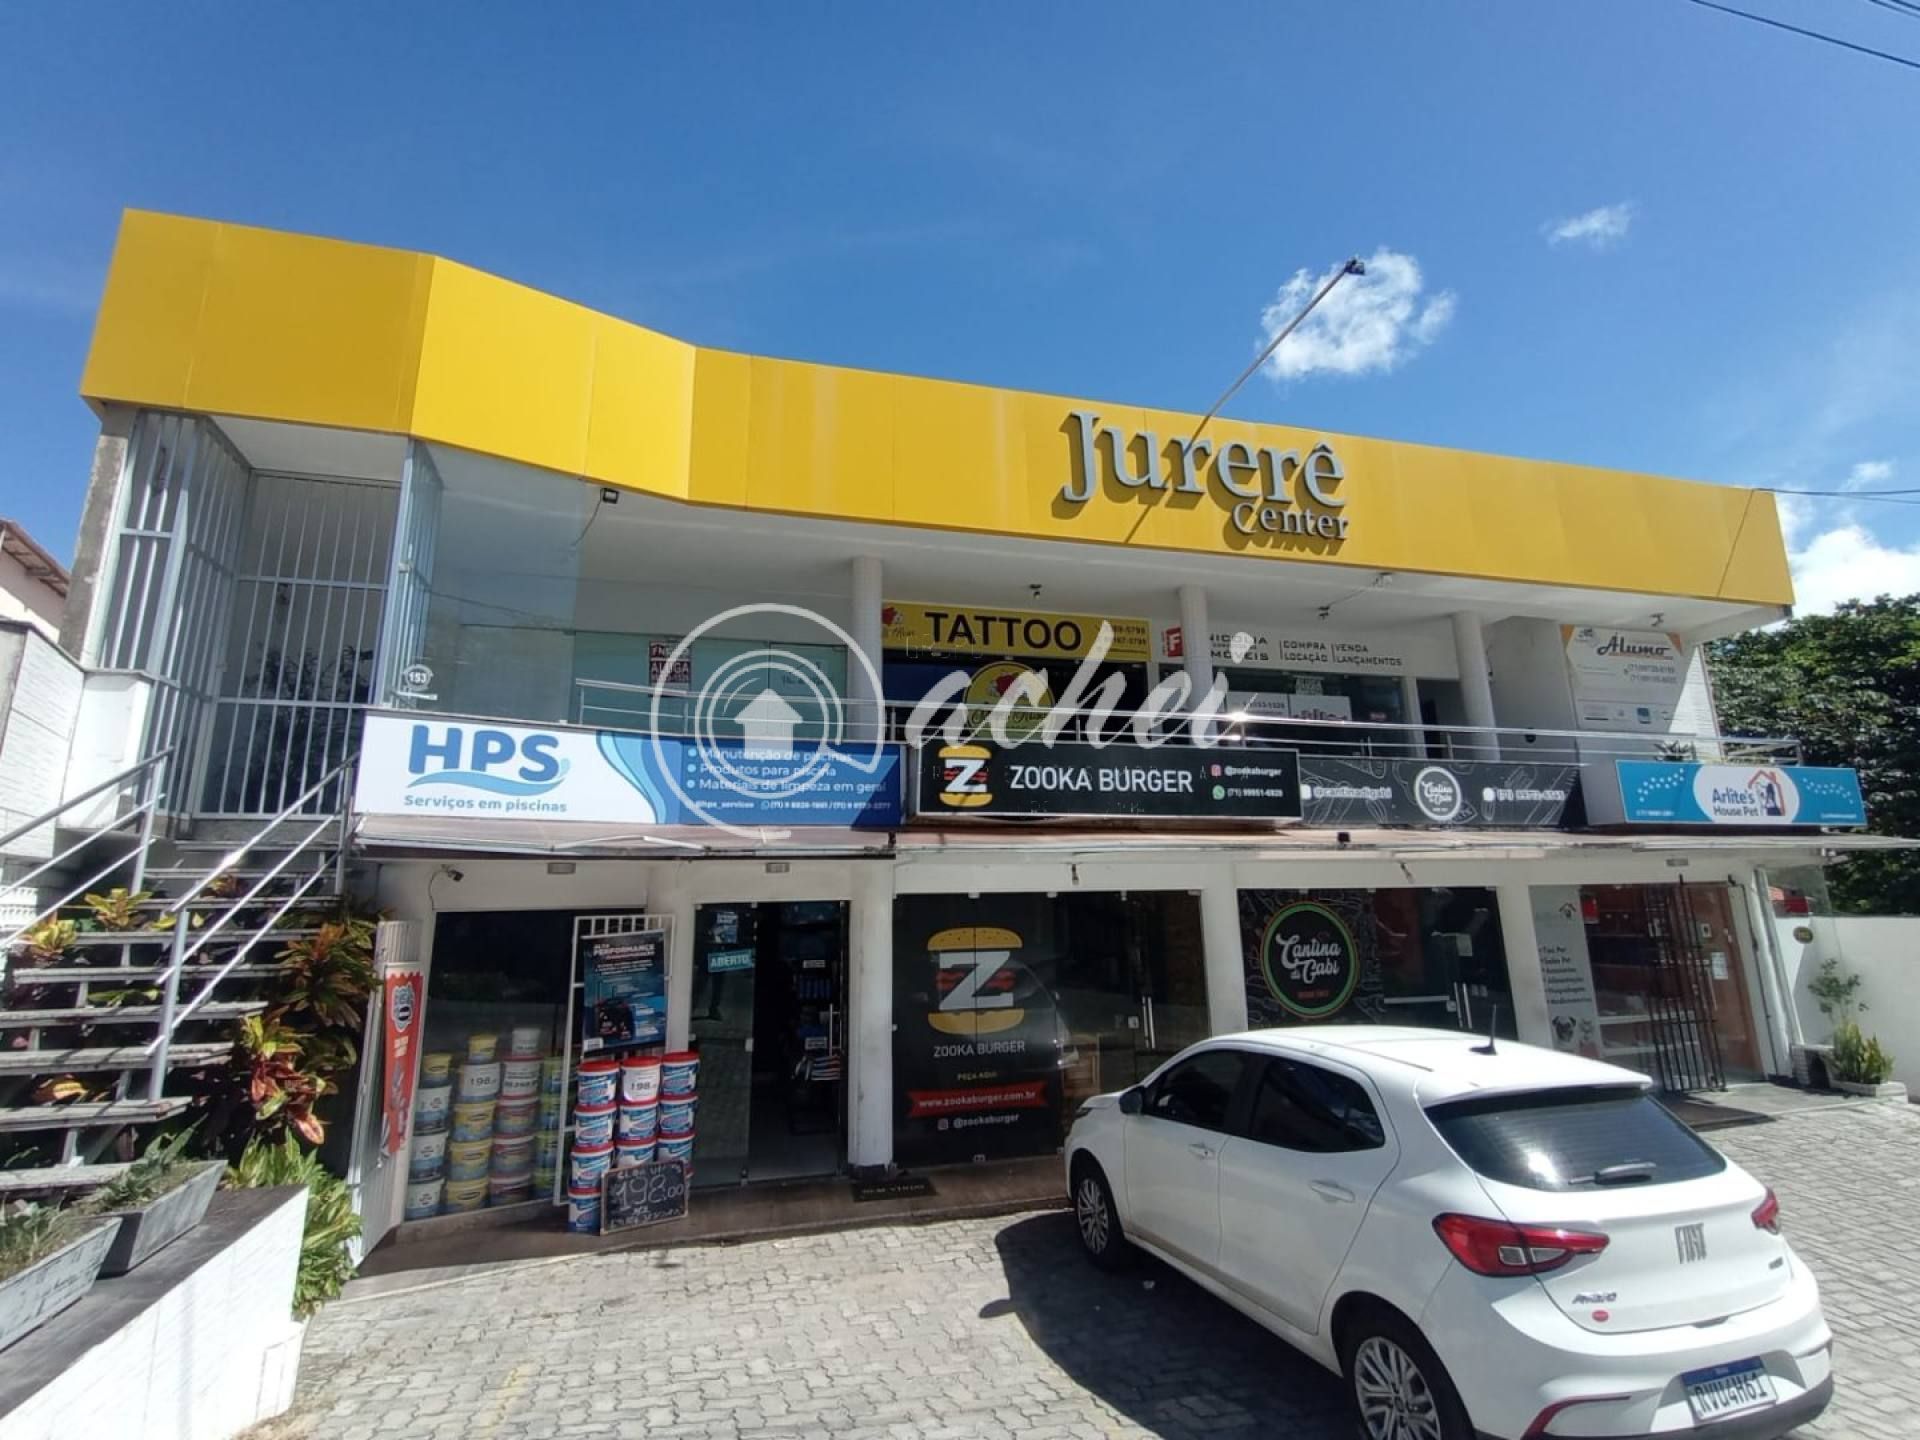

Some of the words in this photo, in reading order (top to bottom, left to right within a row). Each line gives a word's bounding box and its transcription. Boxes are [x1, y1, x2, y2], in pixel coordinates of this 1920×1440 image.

[1062, 409, 1348, 507] Jurerê
[1232, 502, 1349, 540] Center
[924, 611, 1082, 651] TATTOO
[1283, 640, 1327, 651] COMPRA
[1334, 643, 1369, 653] VENDA
[1284, 651, 1329, 663] LOCAÇÃO
[1336, 653, 1403, 667] LANÇAMENTOS
[407, 724, 561, 782] HPS
[700, 764, 759, 776] Produtos
[762, 765, 790, 778] para
[1009, 765, 1093, 792] ZOOKA
[1099, 767, 1194, 793] BURGER
[761, 780, 776, 791] de
[833, 782, 853, 792] em
[856, 781, 887, 794] geral
[404, 795, 475, 811] Serviços
[479, 798, 502, 809] em
[505, 798, 568, 812] piscinas
[1711, 787, 1756, 805] Arlite's
[1713, 805, 1742, 817] House
[1743, 806, 1760, 817] Pet
[1275, 933, 1342, 970] Cantina
[710, 954, 750, 969] ABERTO
[933, 1044, 975, 1059] ZOOKA
[976, 1040, 1026, 1056] BURGER
[918, 1091, 1036, 1108] www.zookaburger.com.br
[953, 1113, 1020, 1129] @zookaburger
[1674, 1223, 1707, 1264] FIAT
